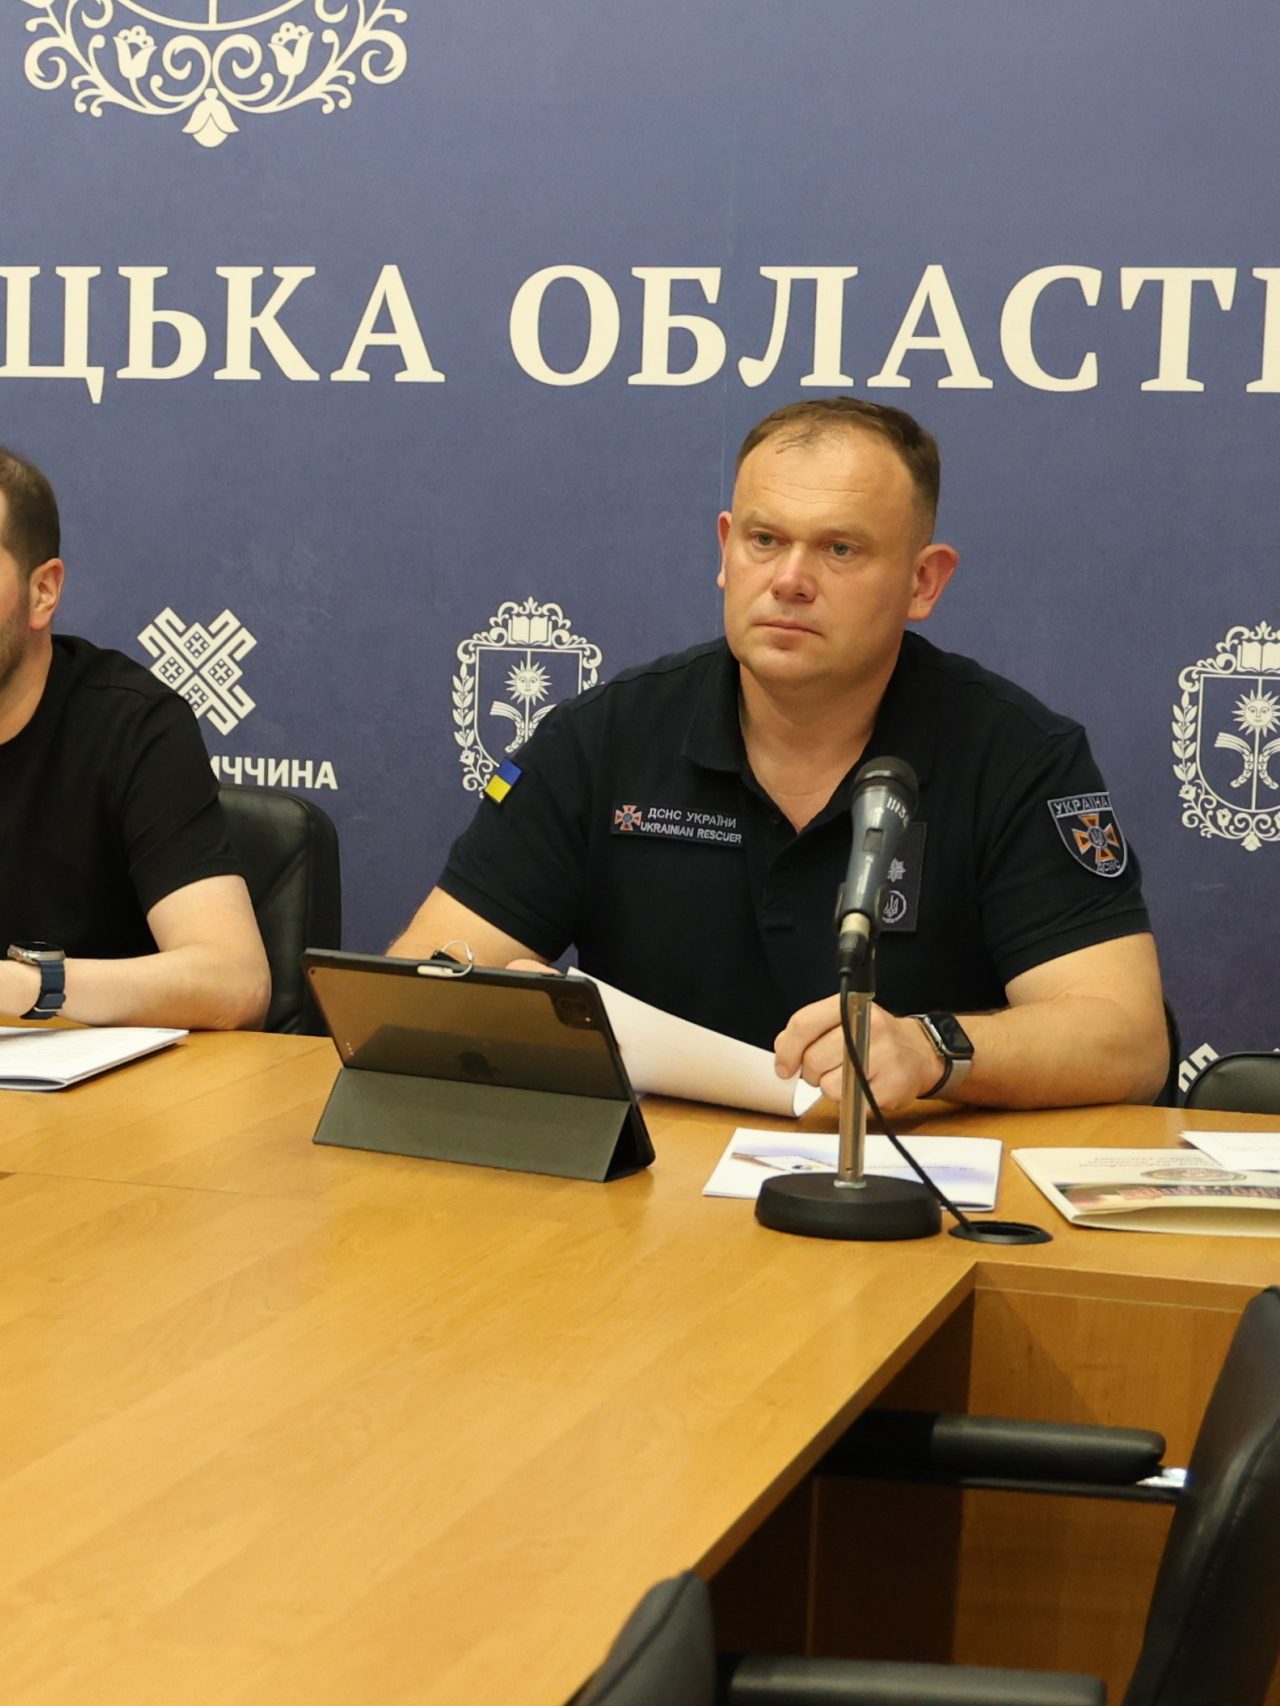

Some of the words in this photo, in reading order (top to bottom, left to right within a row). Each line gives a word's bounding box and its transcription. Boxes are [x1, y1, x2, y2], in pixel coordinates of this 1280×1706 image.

[1053, 796, 1109, 815] УКРАЇНА
[647, 806, 683, 820] ДСНС
[685, 811, 737, 829] УКРАЇНИ
[640, 821, 694, 838] UKRAINIAN
[696, 828, 742, 844] RESCUER
